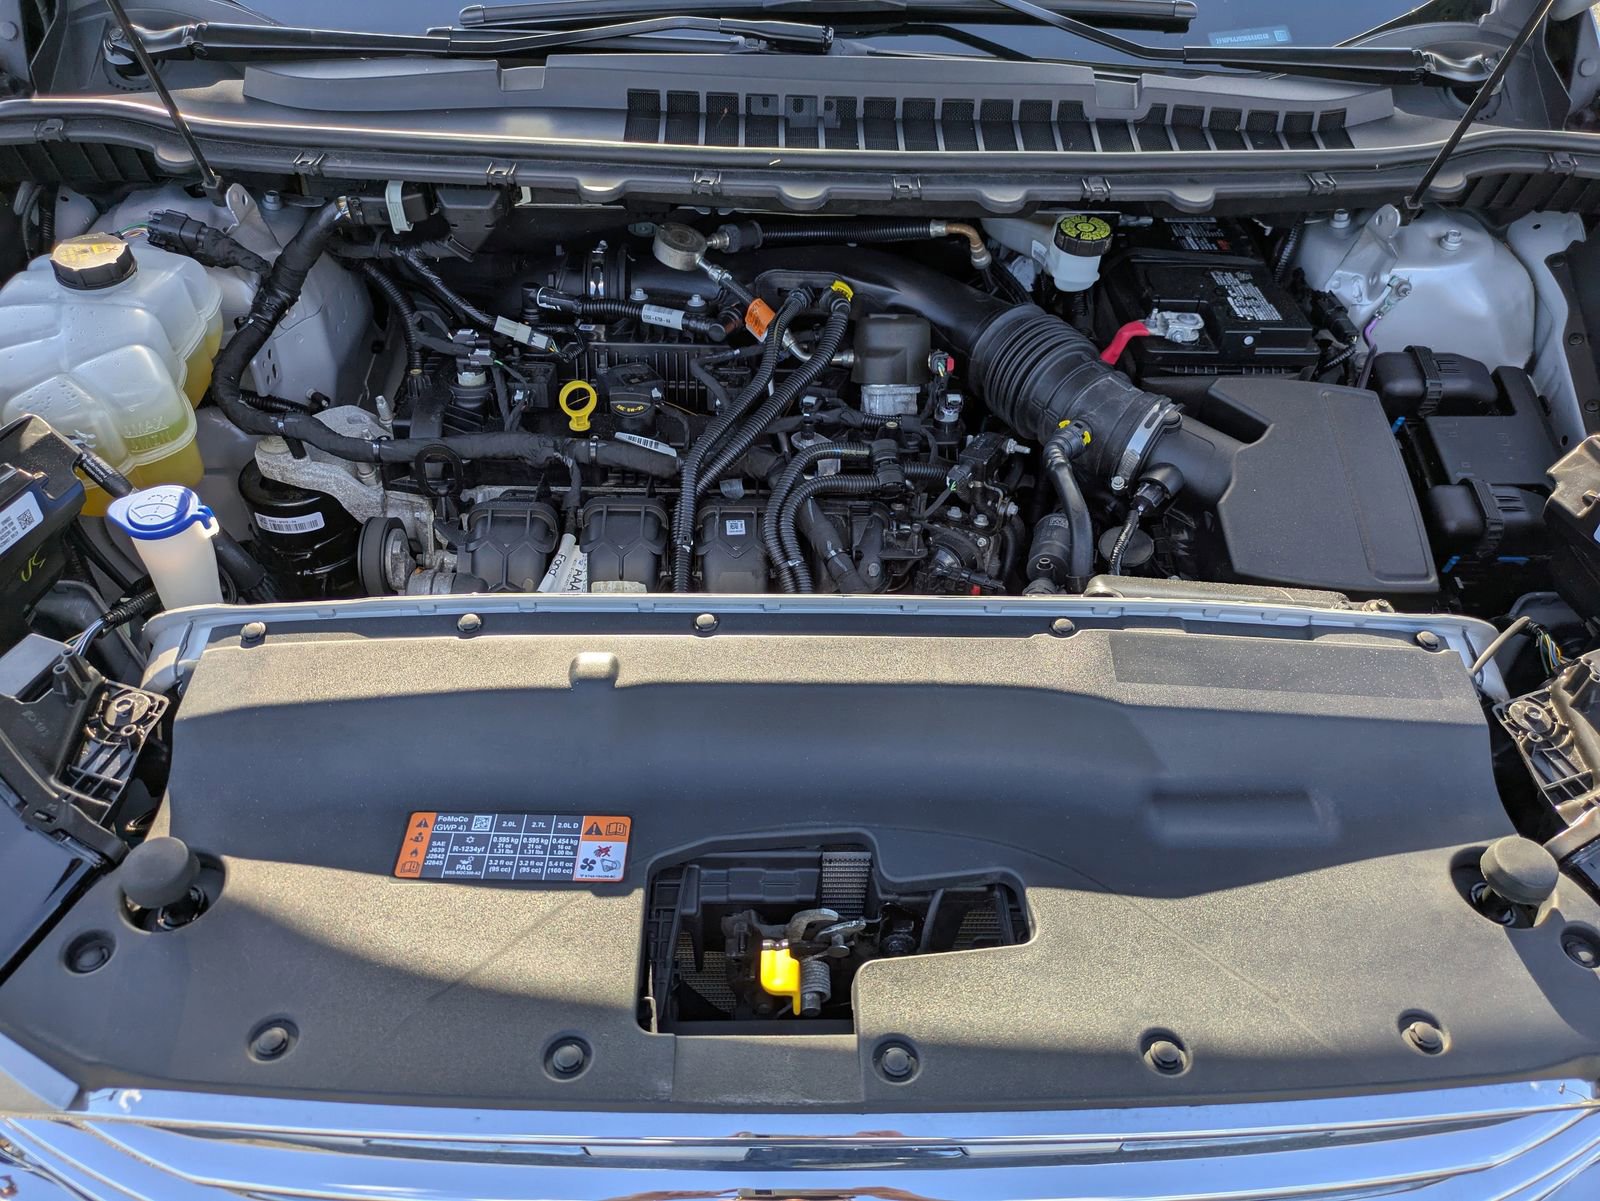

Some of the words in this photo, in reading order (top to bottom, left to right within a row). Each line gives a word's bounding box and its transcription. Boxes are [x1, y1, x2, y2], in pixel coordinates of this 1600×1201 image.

[433, 824, 456, 832] (GWP
[458, 824, 466, 832] 4)
[511, 836, 519, 844] kg
[540, 837, 549, 845] kg
[570, 838, 578, 846] kg
